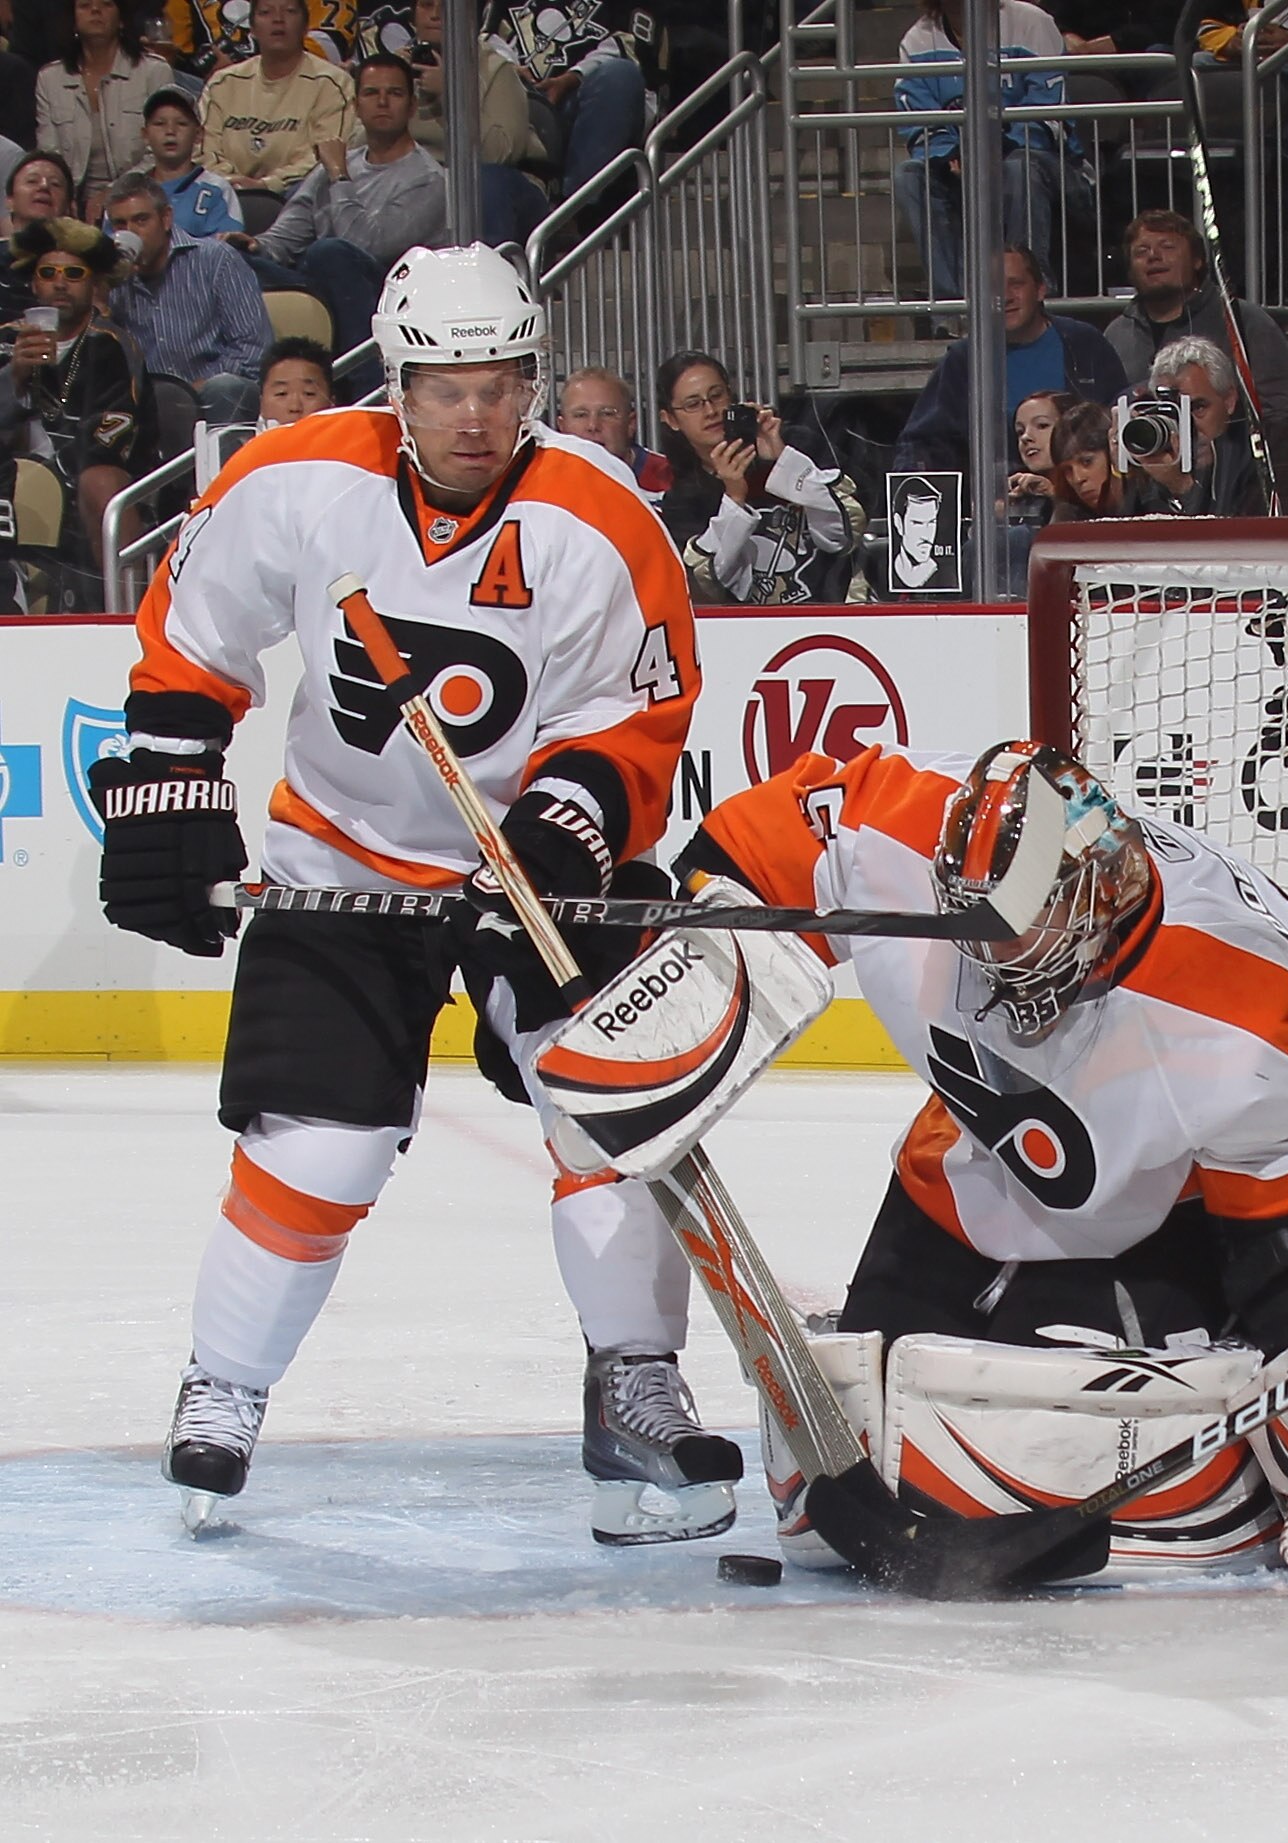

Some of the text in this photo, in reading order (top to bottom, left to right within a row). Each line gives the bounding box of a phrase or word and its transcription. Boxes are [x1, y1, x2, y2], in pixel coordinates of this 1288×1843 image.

[195, 189, 212, 214] C
[450, 325, 497, 339] Reebok
[468, 519, 533, 609] A
[934, 544, 945, 557] DO
[410, 709, 461, 790] Reebok
[105, 780, 239, 820] WARRIO
[591, 940, 705, 1042] Reebok
[753, 1353, 800, 1432] Reebok
